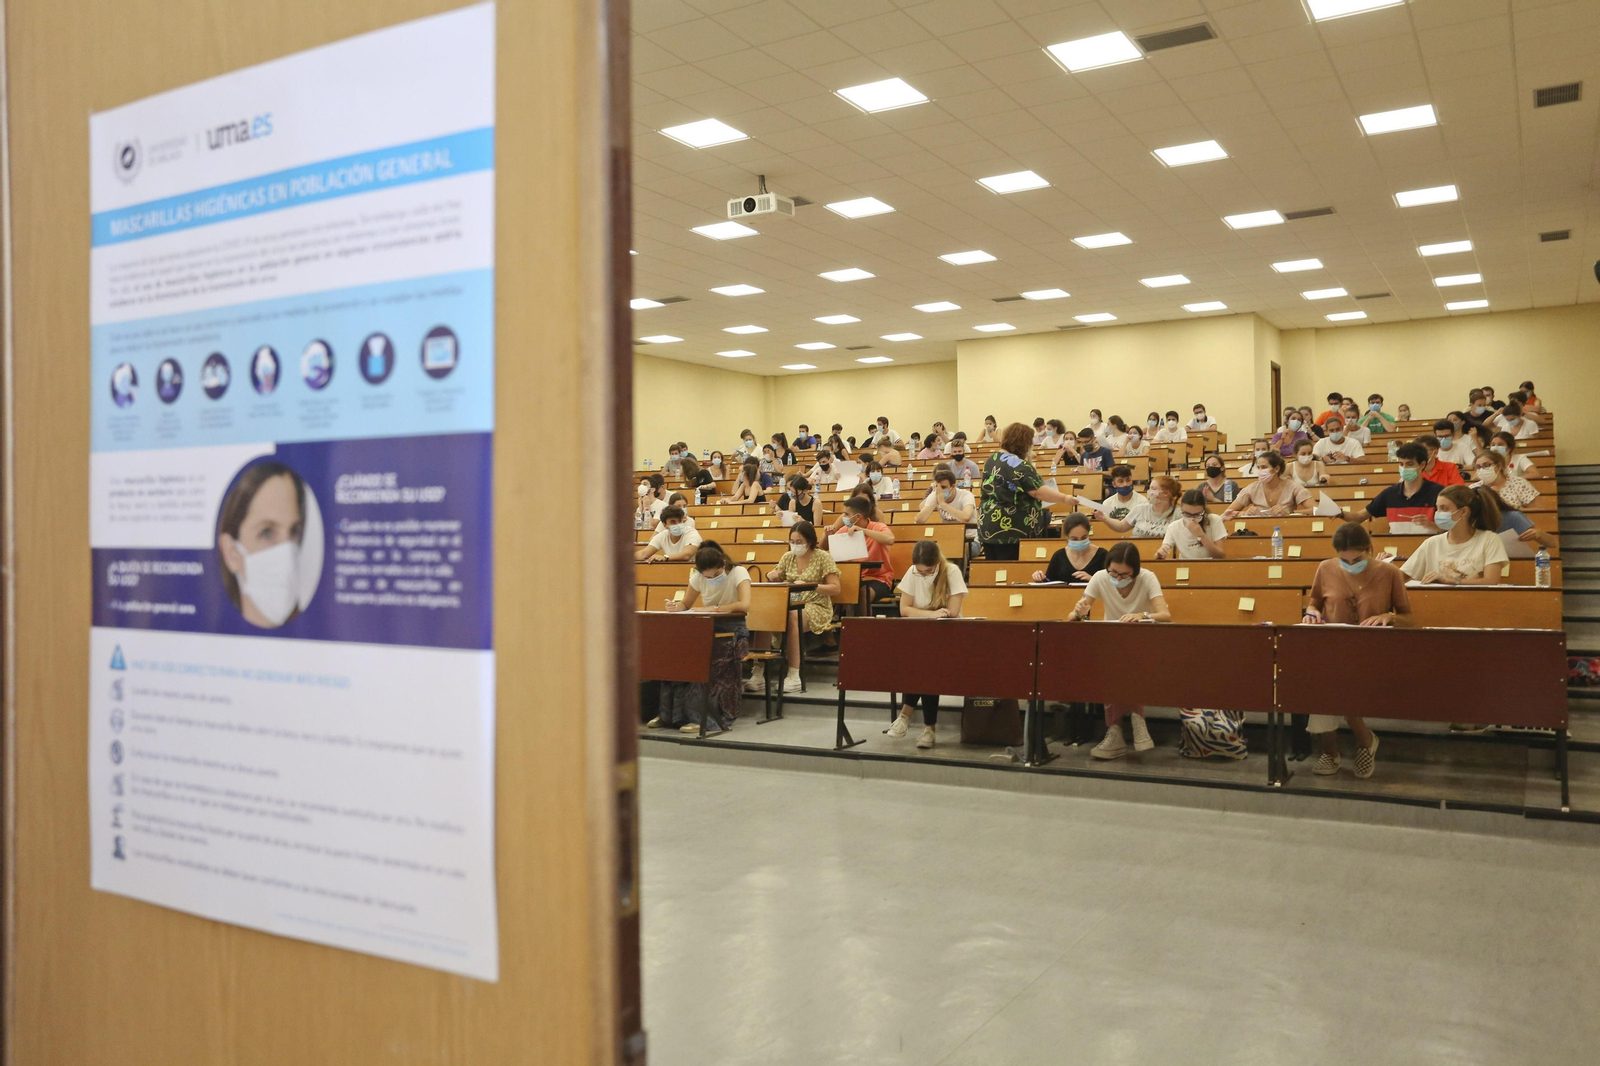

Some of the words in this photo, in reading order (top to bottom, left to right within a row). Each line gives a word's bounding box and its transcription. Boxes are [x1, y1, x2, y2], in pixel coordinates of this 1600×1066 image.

[206, 111, 274, 151] uma.es
[109, 203, 193, 237] MASCARILLAS
[268, 182, 288, 204] EN
[289, 161, 374, 199] POBLACIÓN
[376, 147, 455, 182] GENERAL
